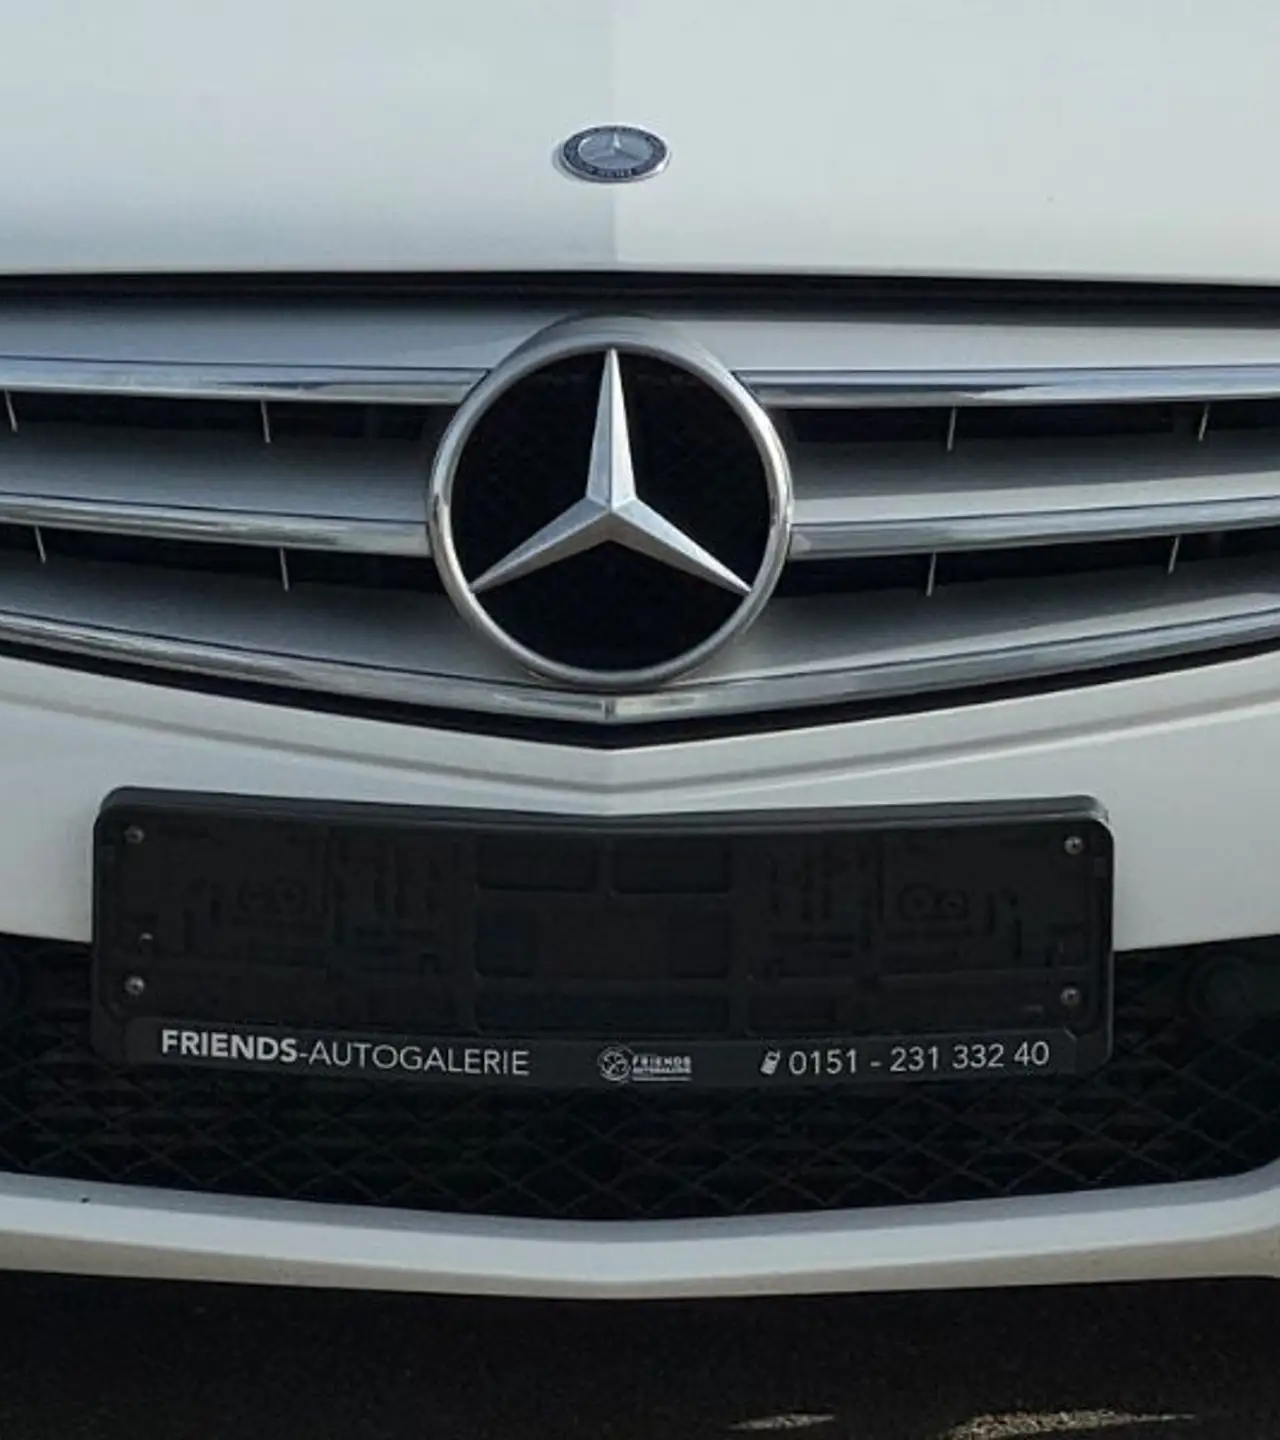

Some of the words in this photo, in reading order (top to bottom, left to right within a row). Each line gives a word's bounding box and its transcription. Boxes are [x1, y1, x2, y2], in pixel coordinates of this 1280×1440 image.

[161, 1029, 530, 1076] FRIENDS-AUTOGALERIE
[788, 1049, 858, 1075] 0151
[889, 1046, 941, 1073] 231
[951, 1043, 1005, 1069] 332
[1013, 1041, 1051, 1066] 40
